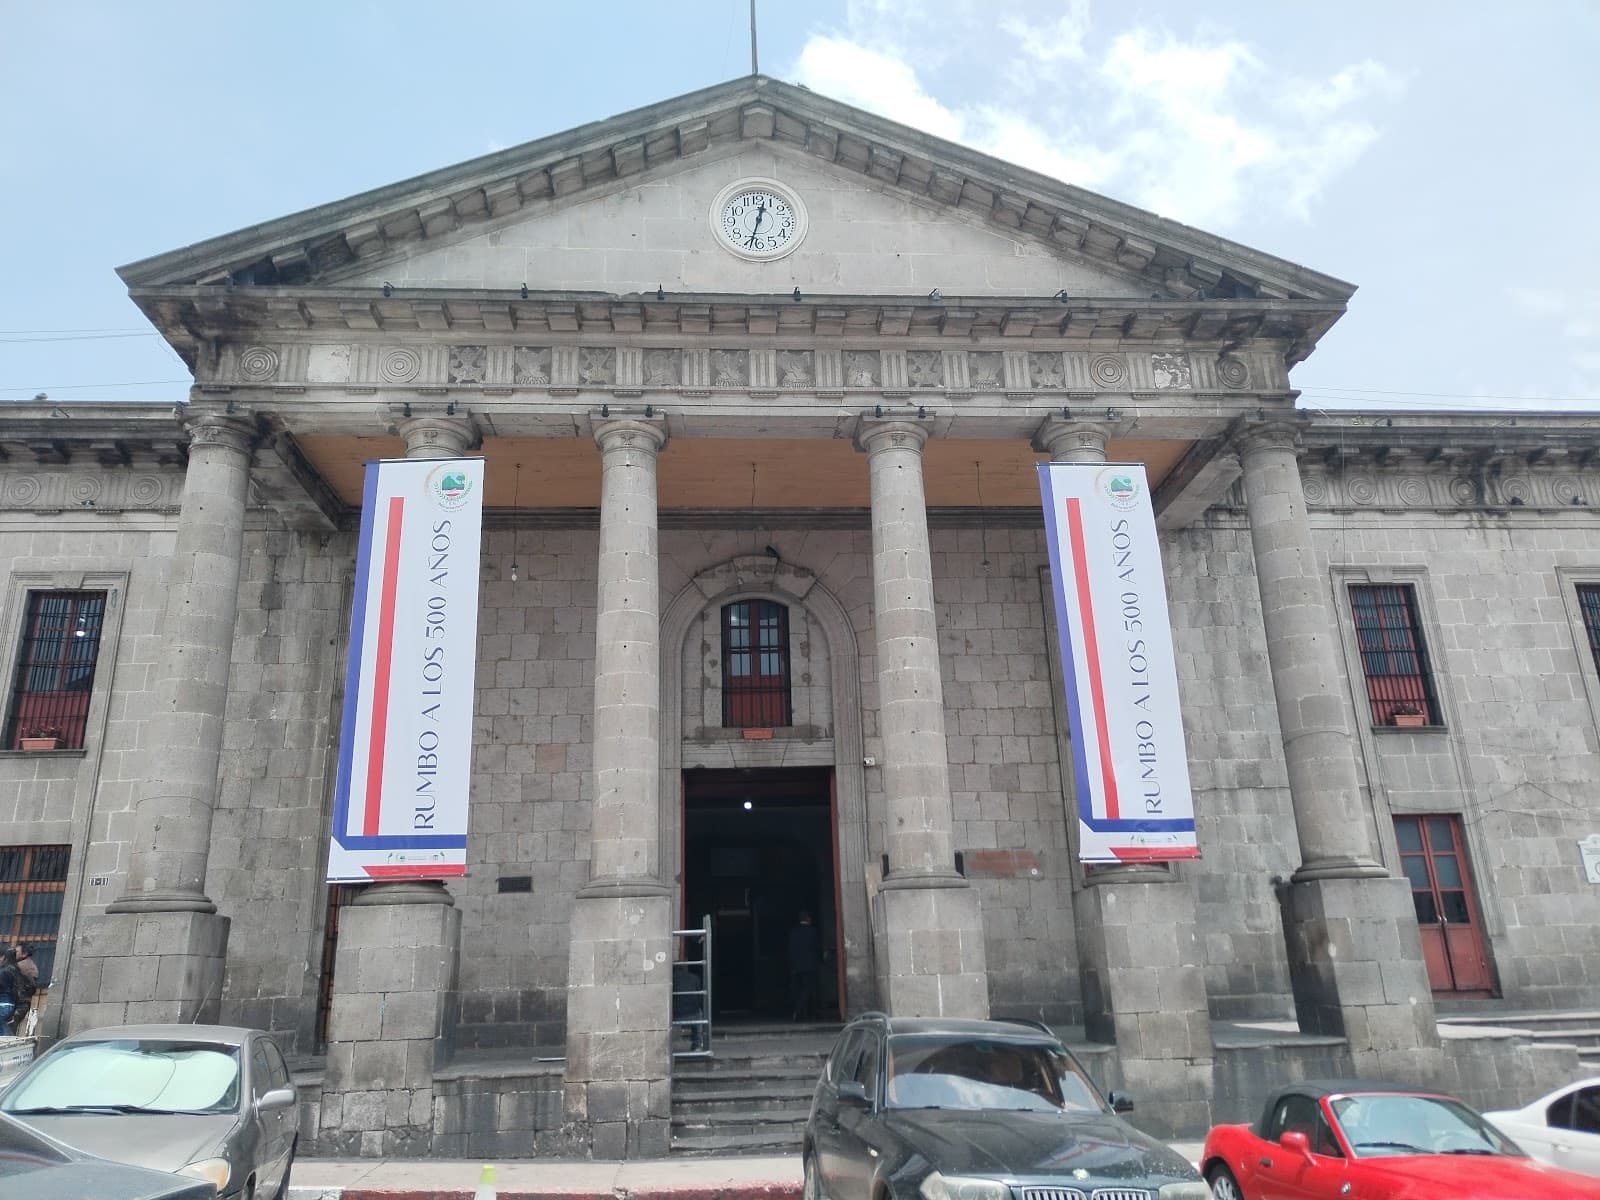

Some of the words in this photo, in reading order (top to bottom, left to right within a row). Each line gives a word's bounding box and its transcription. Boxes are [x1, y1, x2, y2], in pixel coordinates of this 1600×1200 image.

[743, 197, 750, 206] 11
[753, 196, 764, 205] 12
[769, 199, 773, 207] 1
[731, 206, 743, 216] 10
[776, 206, 785, 215] 2
[727, 217, 735, 227] 9
[782, 217, 790, 227] 3
[733, 229, 741, 239] 8
[778, 229, 785, 239] 4
[755, 239, 764, 249] 6
[768, 237, 776, 247] 5
[428, 520, 452, 588] AÑOS
[1111, 519, 1136, 584] AÑOS
[1121, 592, 1143, 632] 500
[425, 596, 447, 639] 500
[1128, 640, 1149, 685] LOS
[422, 647, 444, 695] LOS
[1134, 694, 1152, 712] A
[420, 703, 440, 722] A
[1136, 721, 1163, 813] RUMBO
[414, 731, 439, 830] RUMBO
